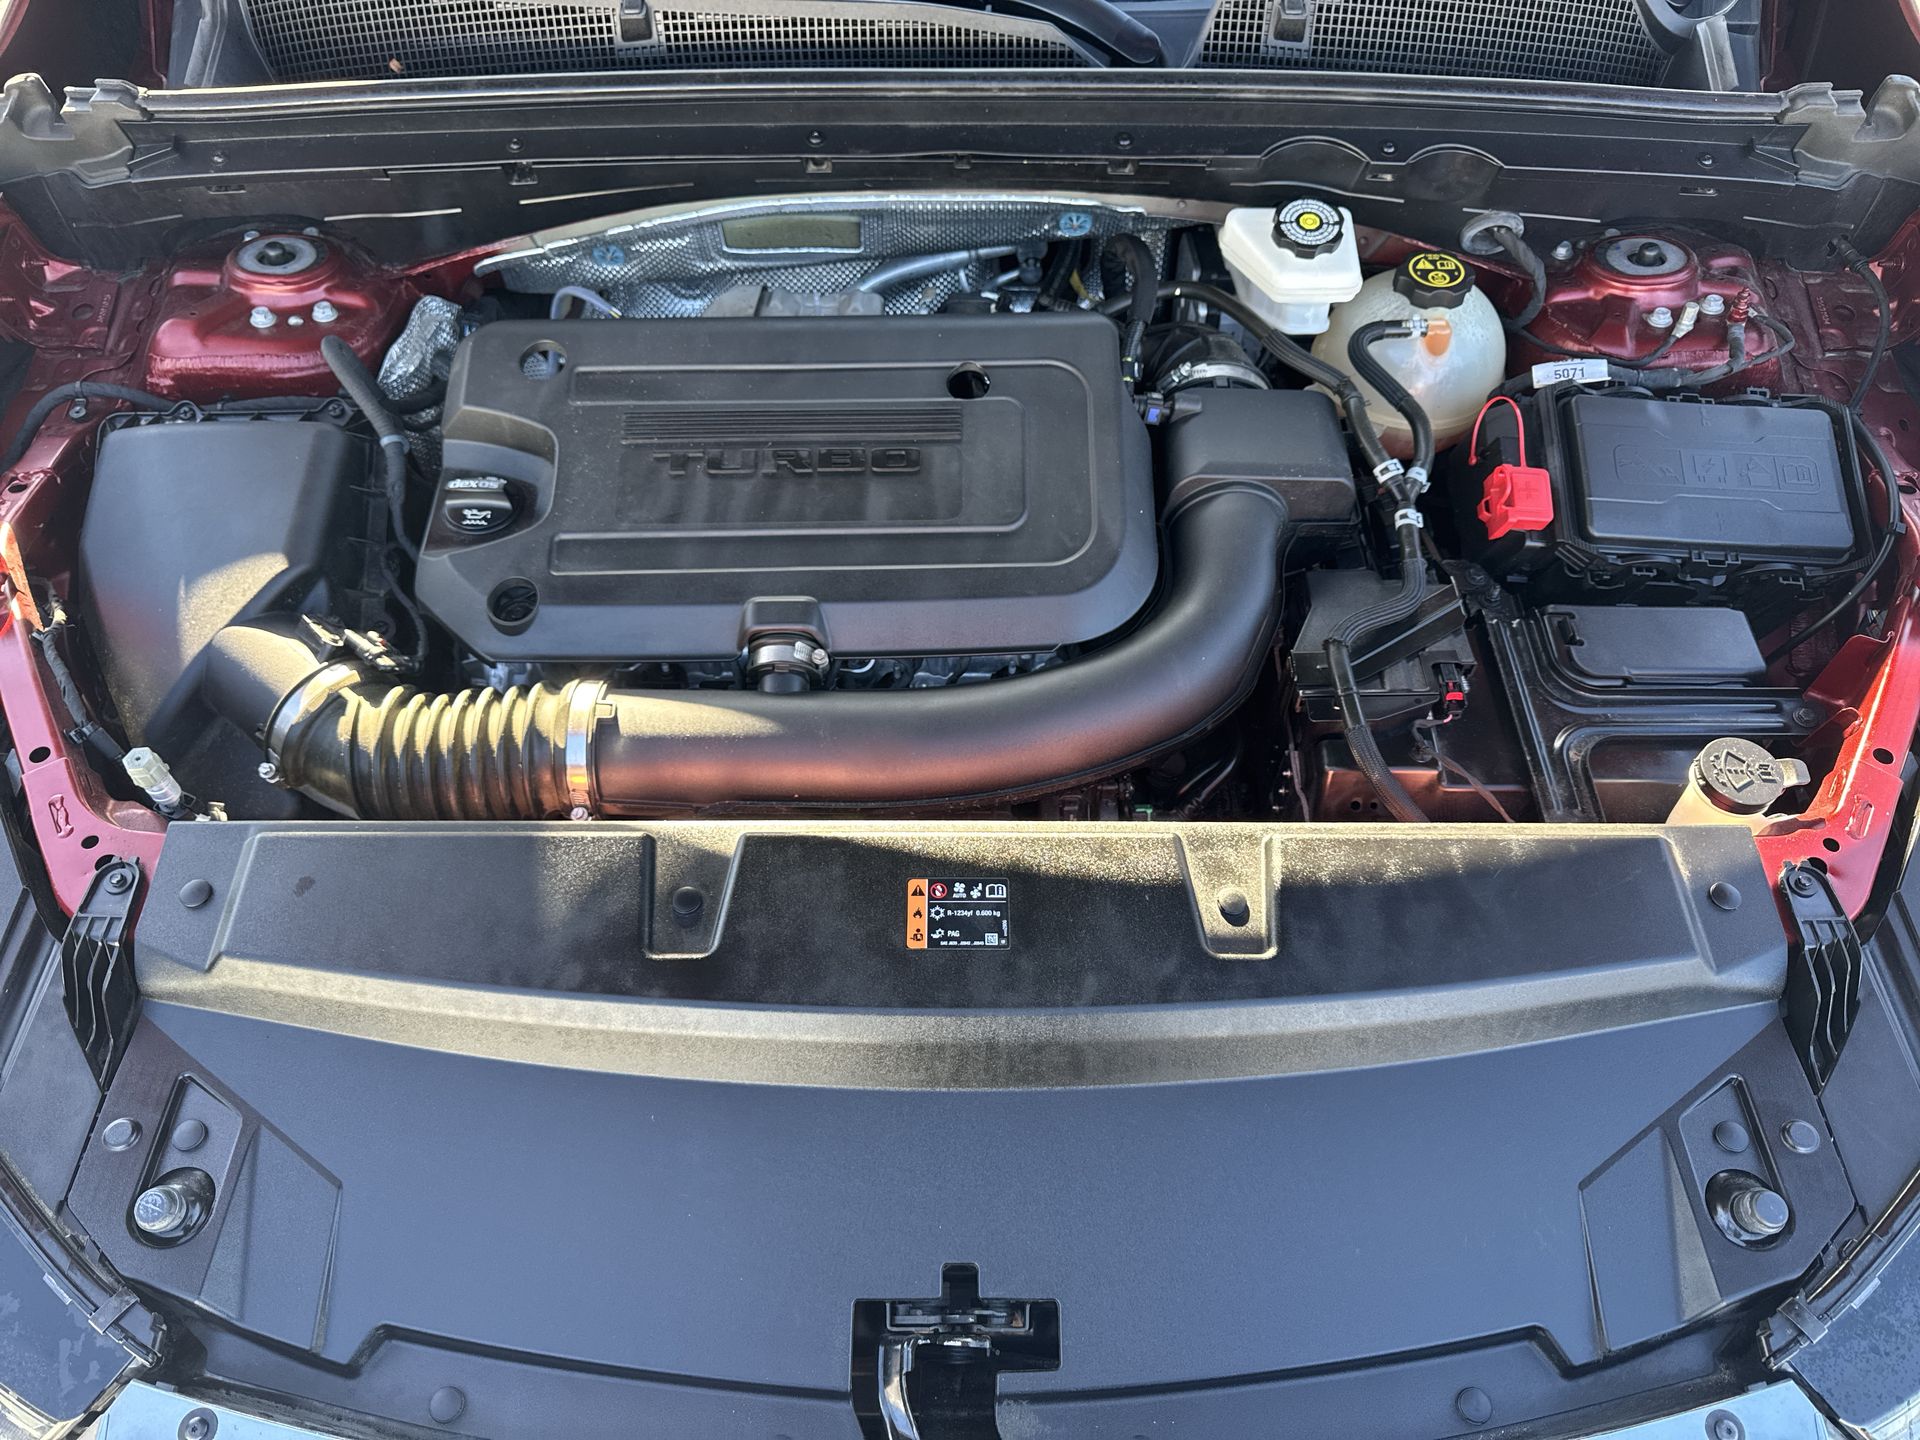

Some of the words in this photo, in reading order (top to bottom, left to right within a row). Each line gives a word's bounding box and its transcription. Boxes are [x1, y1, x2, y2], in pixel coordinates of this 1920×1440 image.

[1554, 367, 1585, 379] 5071
[652, 448, 921, 475] TURBO
[447, 479, 499, 488] dexos
[947, 909, 973, 917] R-1234yf
[993, 909, 1001, 917] kg
